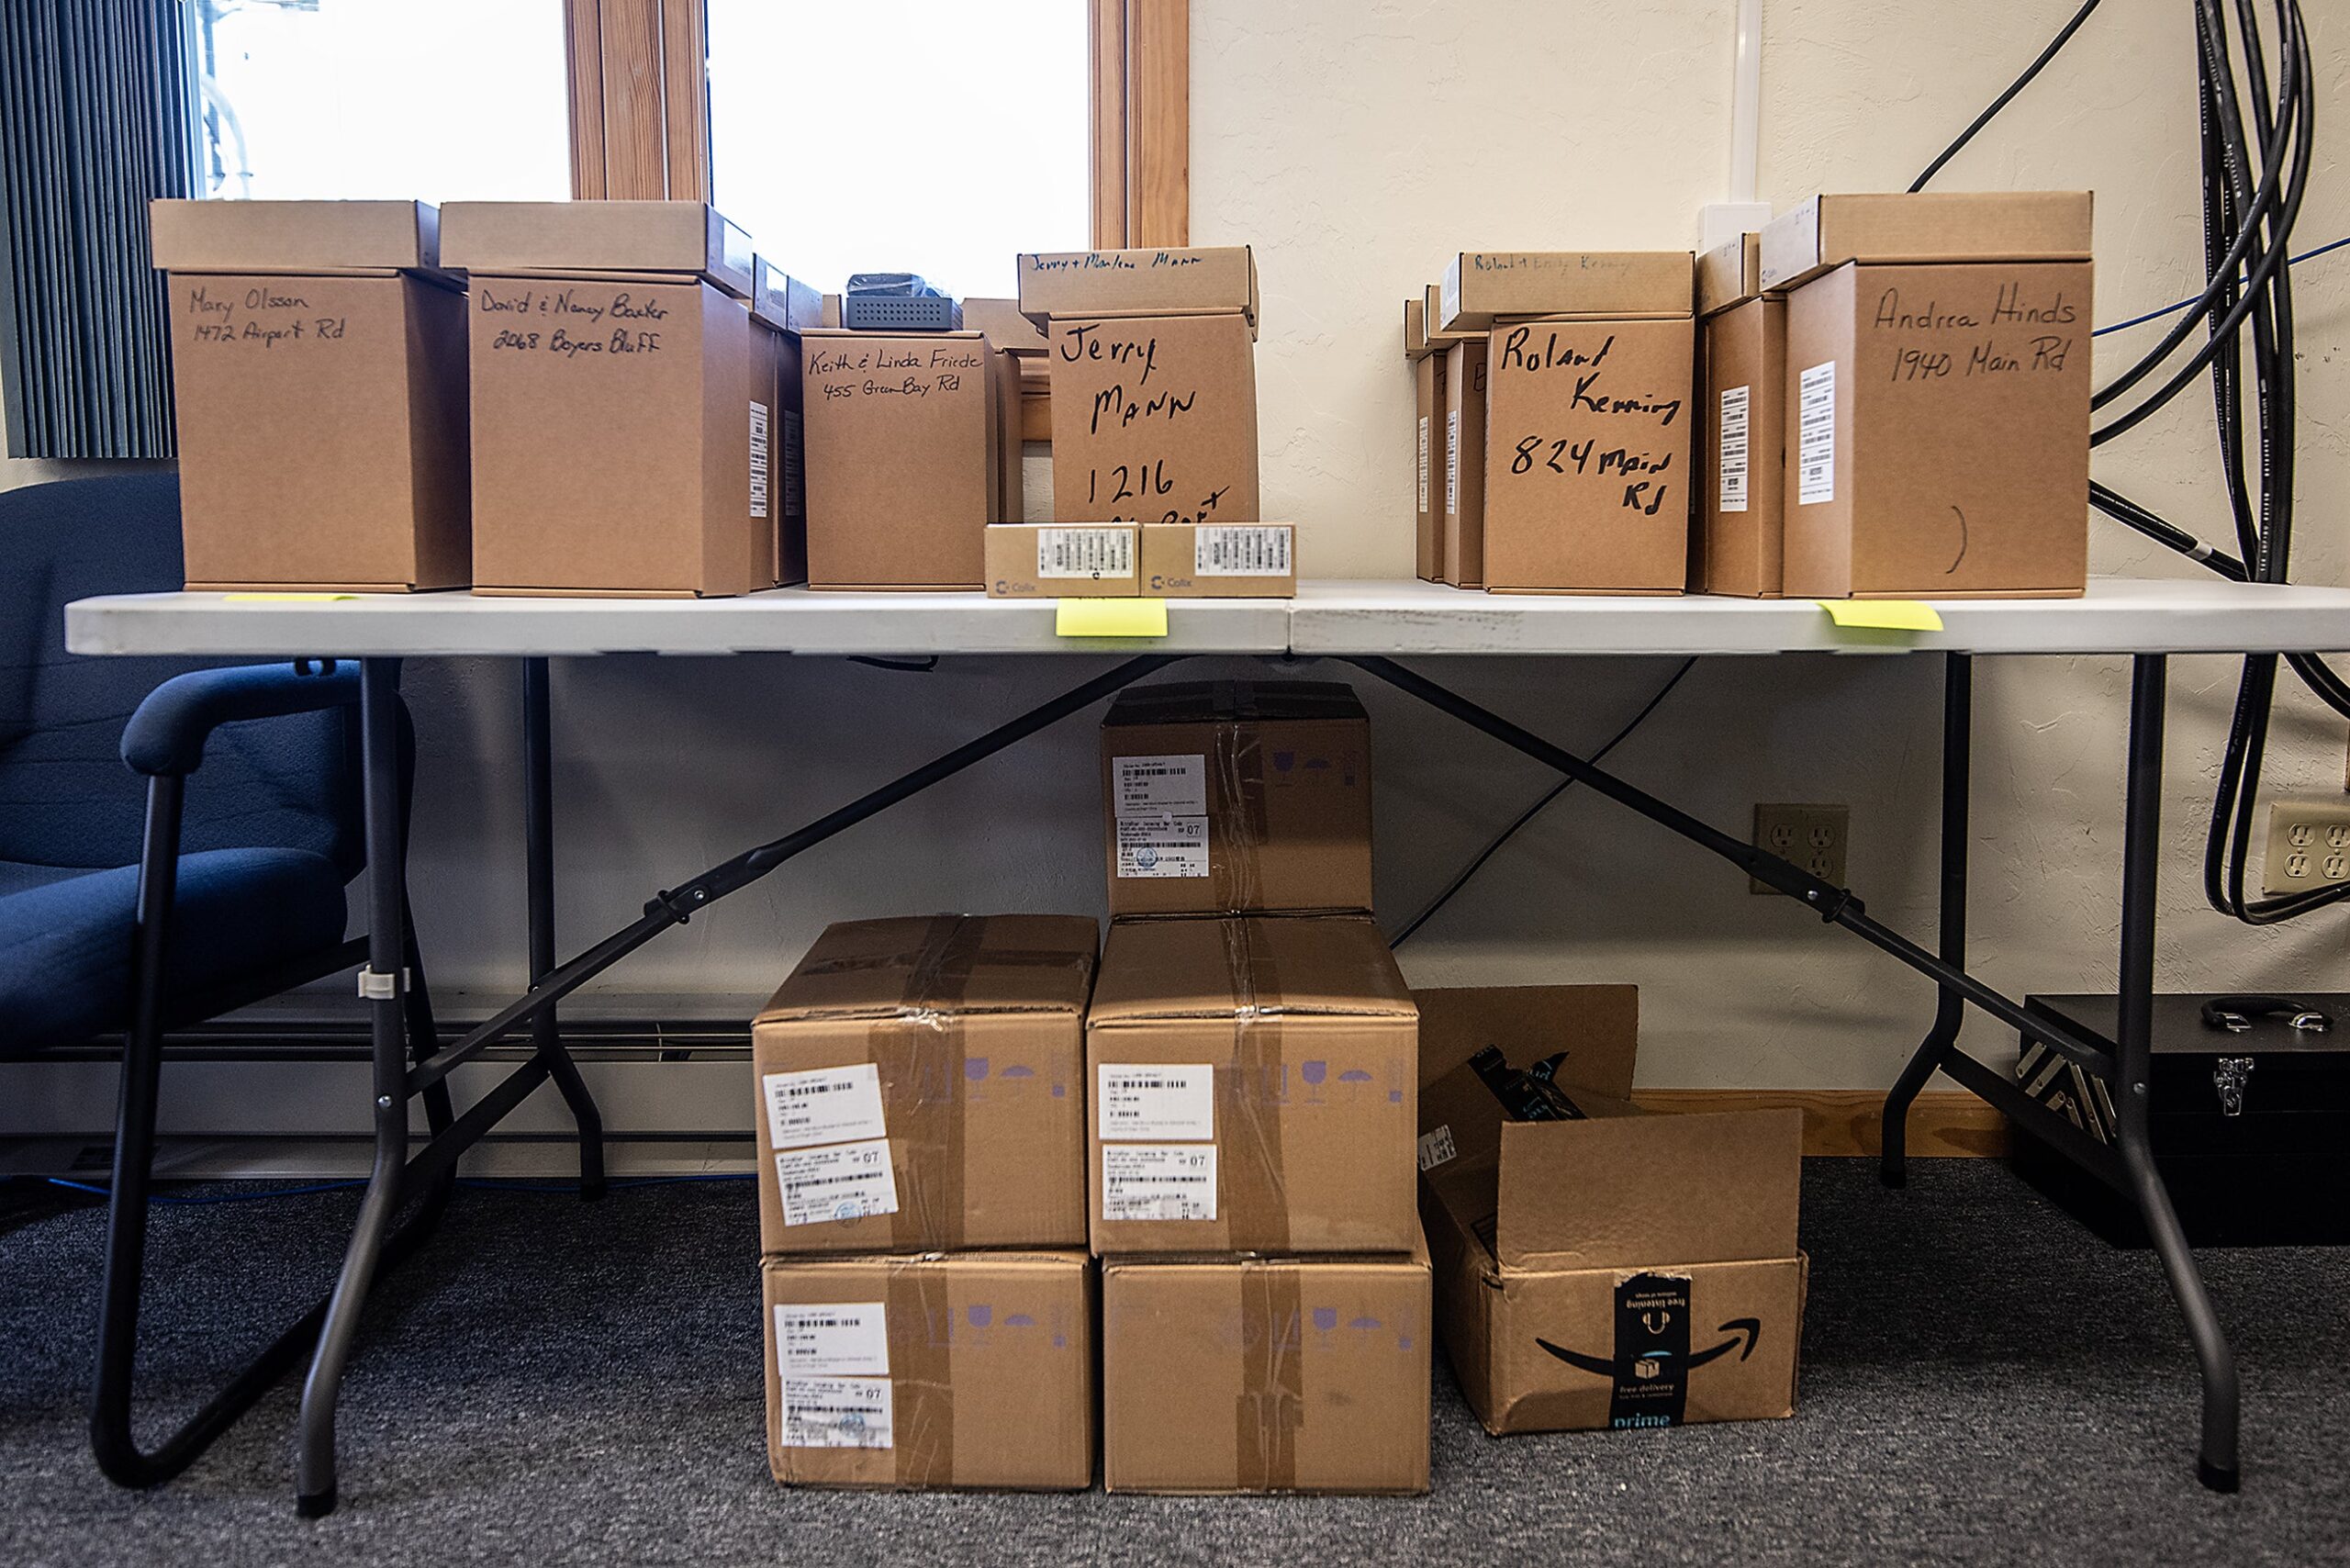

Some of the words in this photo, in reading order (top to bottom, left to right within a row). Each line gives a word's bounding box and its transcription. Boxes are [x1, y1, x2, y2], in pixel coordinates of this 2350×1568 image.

[1030, 253, 1068, 273] Jerry
[190, 286, 232, 320] Mary
[244, 289, 309, 309] Olsson
[481, 289, 531, 313] David
[554, 289, 604, 322] Nancy
[610, 293, 668, 320] Baxter
[1874, 287, 1979, 330] Andrea
[1991, 282, 2076, 325] Hinds
[195, 324, 236, 342] 1472
[242, 320, 304, 348] Airport
[316, 319, 345, 339] Rd
[493, 330, 540, 351] 2068
[550, 329, 603, 358] Boyers
[809, 351, 854, 375] Keith
[877, 349, 923, 369] Linda
[930, 348, 984, 369] Friede
[1060, 323, 1157, 386] Jerry
[1501, 327, 1615, 372] Roland
[1891, 348, 1953, 383] 1940
[1965, 340, 2020, 376] Main
[2030, 336, 2074, 372] Rd
[823, 384, 856, 400] 455
[936, 374, 960, 391] Rd
[1511, 435, 1595, 476] 824
[1089, 459, 1174, 504] 1216
[1622, 482, 1668, 516] Rd
[1187, 824, 1201, 834] 07
[863, 1150, 879, 1164] 07
[1190, 1156, 1205, 1166] 07
[1626, 1298, 1666, 1309] listening
[1667, 1297, 1685, 1307] free
[1619, 1385, 1638, 1394] free
[1639, 1383, 1675, 1394] delivery
